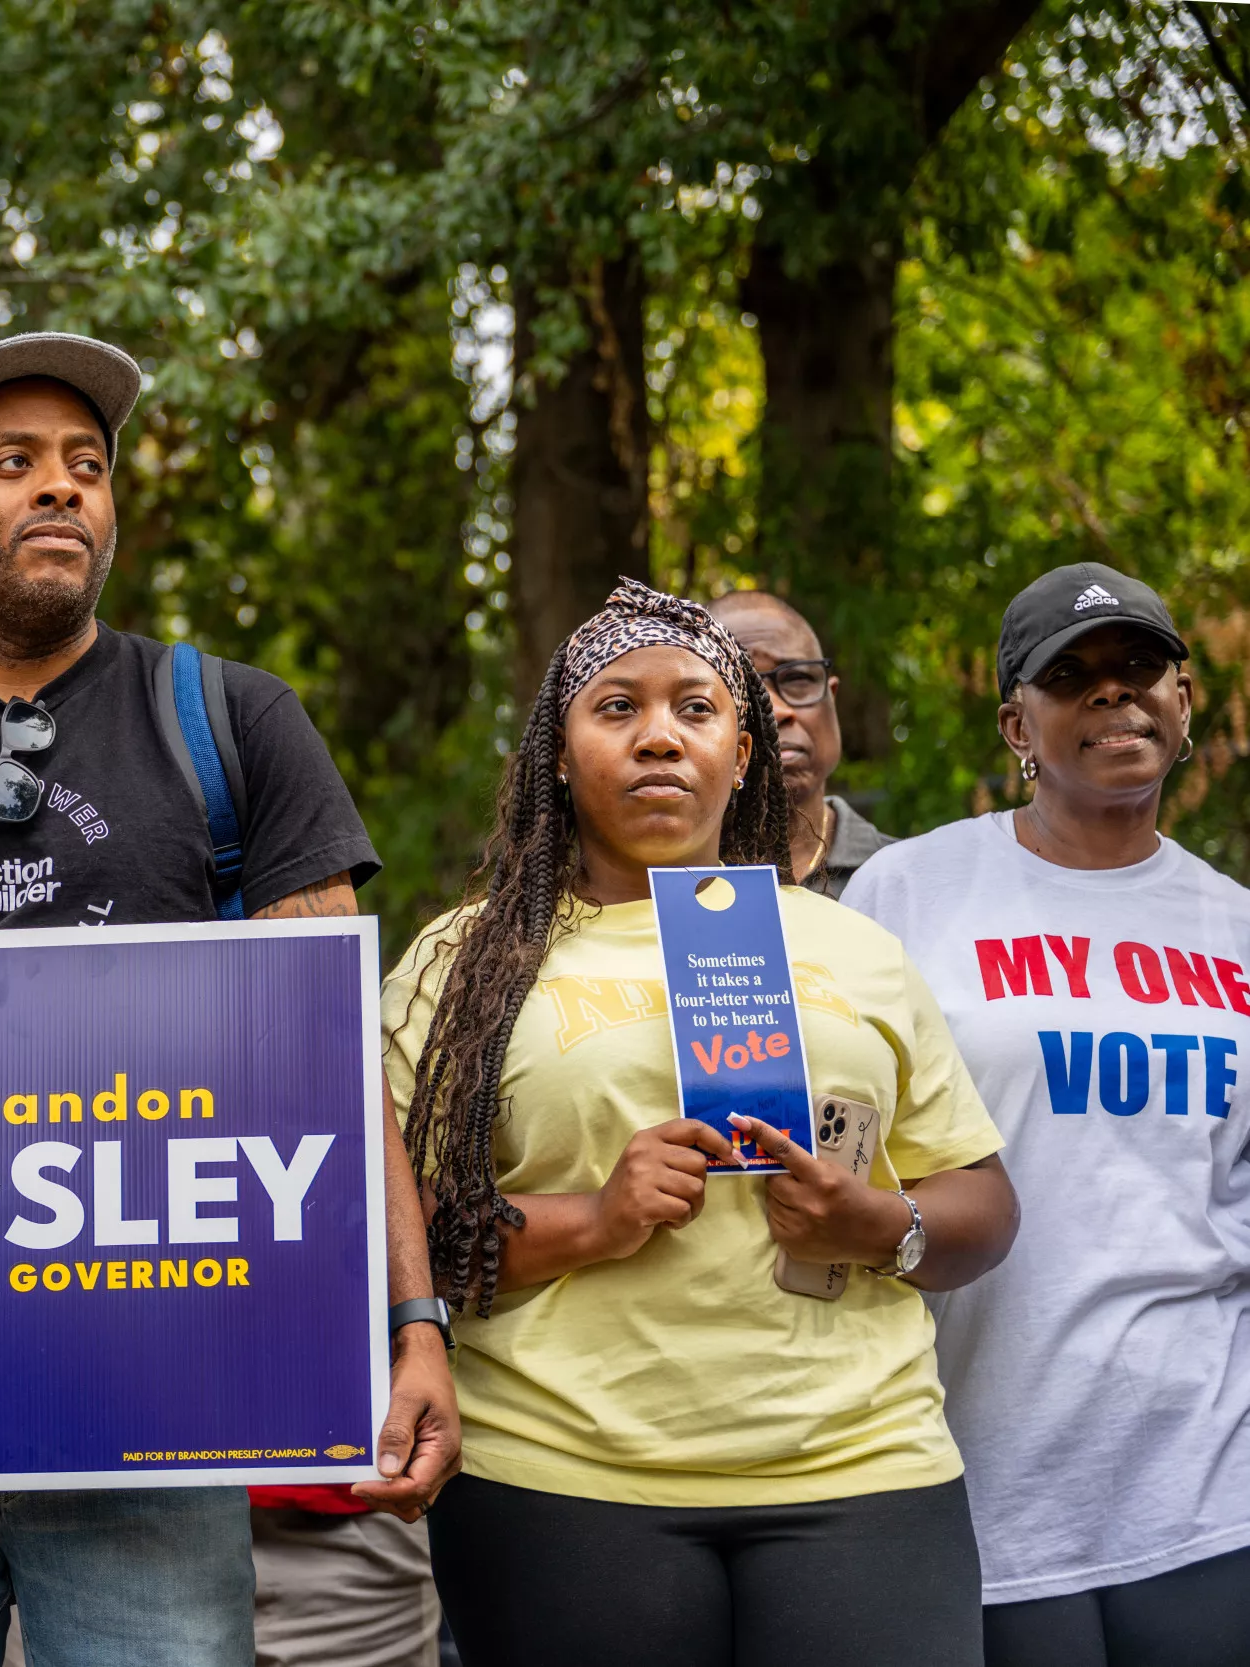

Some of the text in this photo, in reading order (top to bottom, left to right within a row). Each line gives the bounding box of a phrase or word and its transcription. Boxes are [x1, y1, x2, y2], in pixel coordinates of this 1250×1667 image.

[1074, 596, 1119, 611] adidas
[38, 779, 109, 845] WER
[687, 953, 765, 968] Sometimes
[697, 972, 762, 988] it takes a
[974, 934, 1250, 1017] MY ONE
[674, 990, 790, 1007] four-letter word
[692, 1010, 779, 1027] to be heard.
[690, 1030, 791, 1075] Vote
[1037, 1031, 1238, 1120] VOTE
[9, 1258, 250, 1292] GOVERNOR
[123, 1452, 143, 1461] PAID
[145, 1451, 164, 1461] FOR
[165, 1451, 176, 1460] BY
[178, 1450, 226, 1460] BRANDON
[227, 1450, 263, 1459] PRESLEY
[264, 1448, 316, 1458] CAMPAIGN
